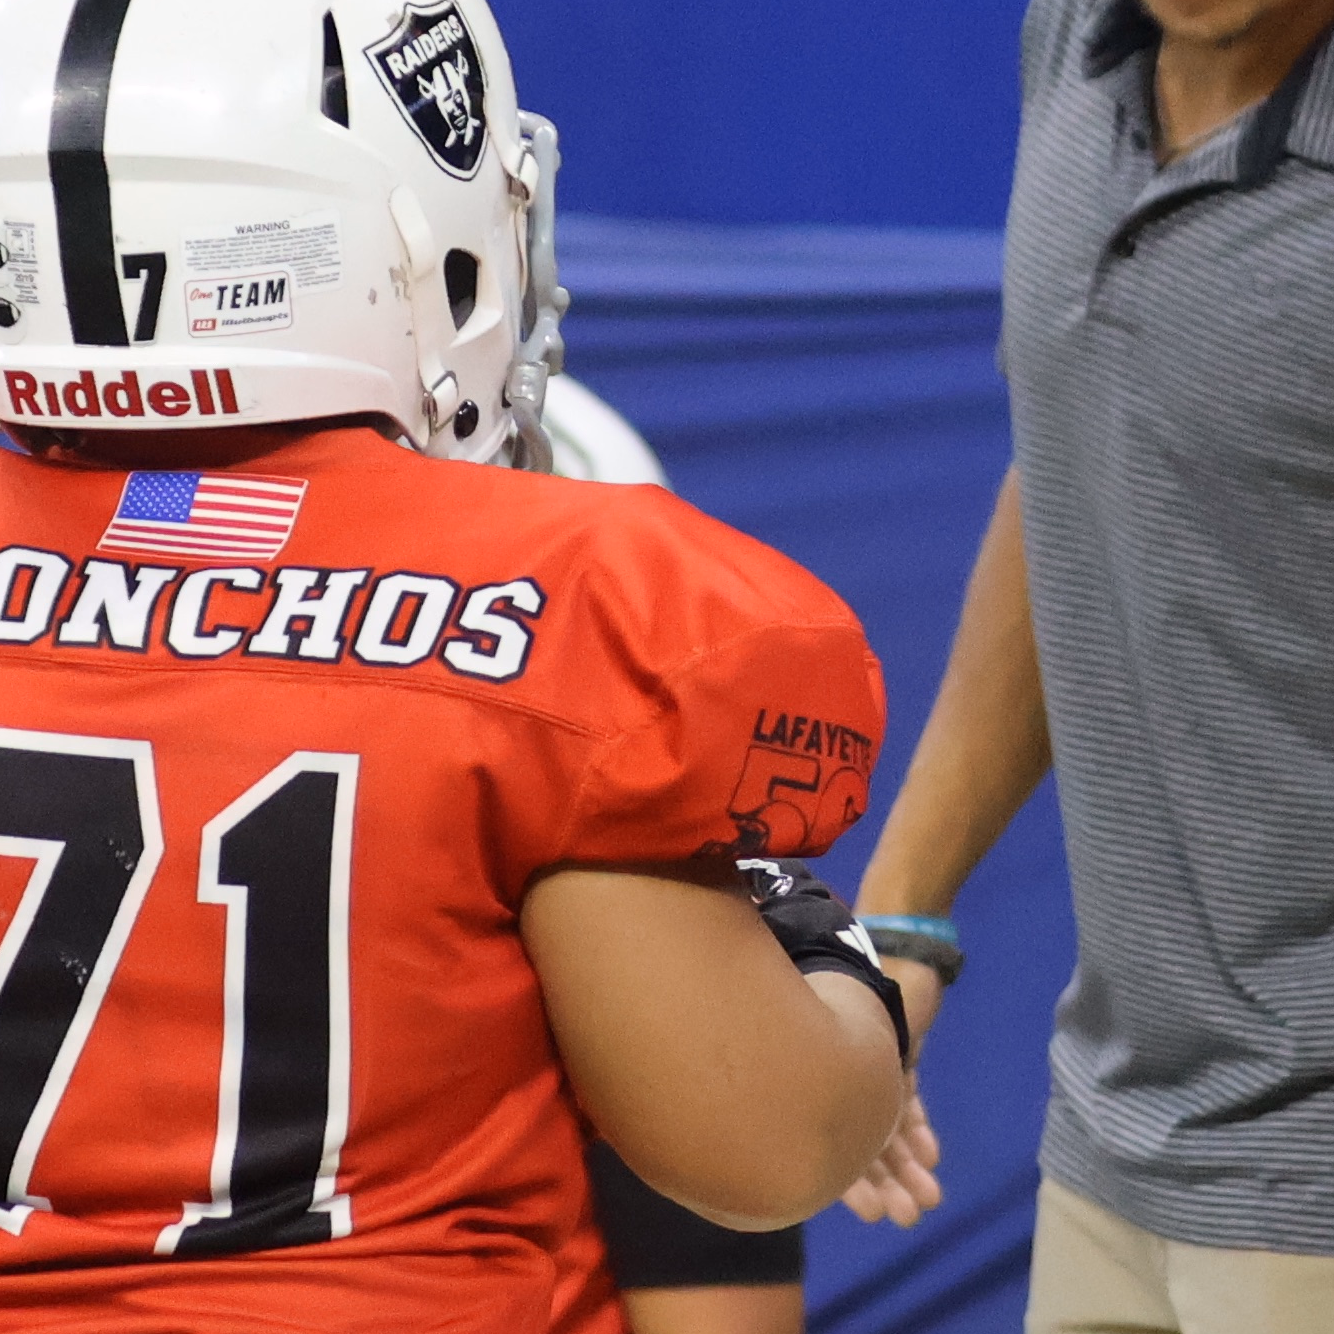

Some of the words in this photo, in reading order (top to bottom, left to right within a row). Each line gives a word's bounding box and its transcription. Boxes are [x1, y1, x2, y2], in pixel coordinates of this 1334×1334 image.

[385, 14, 464, 80] RAIDERS
[235, 220, 290, 234] WARNING
[120, 251, 167, 343] 7
[216, 278, 286, 311] TEAM
[4, 368, 241, 418] Riddell
